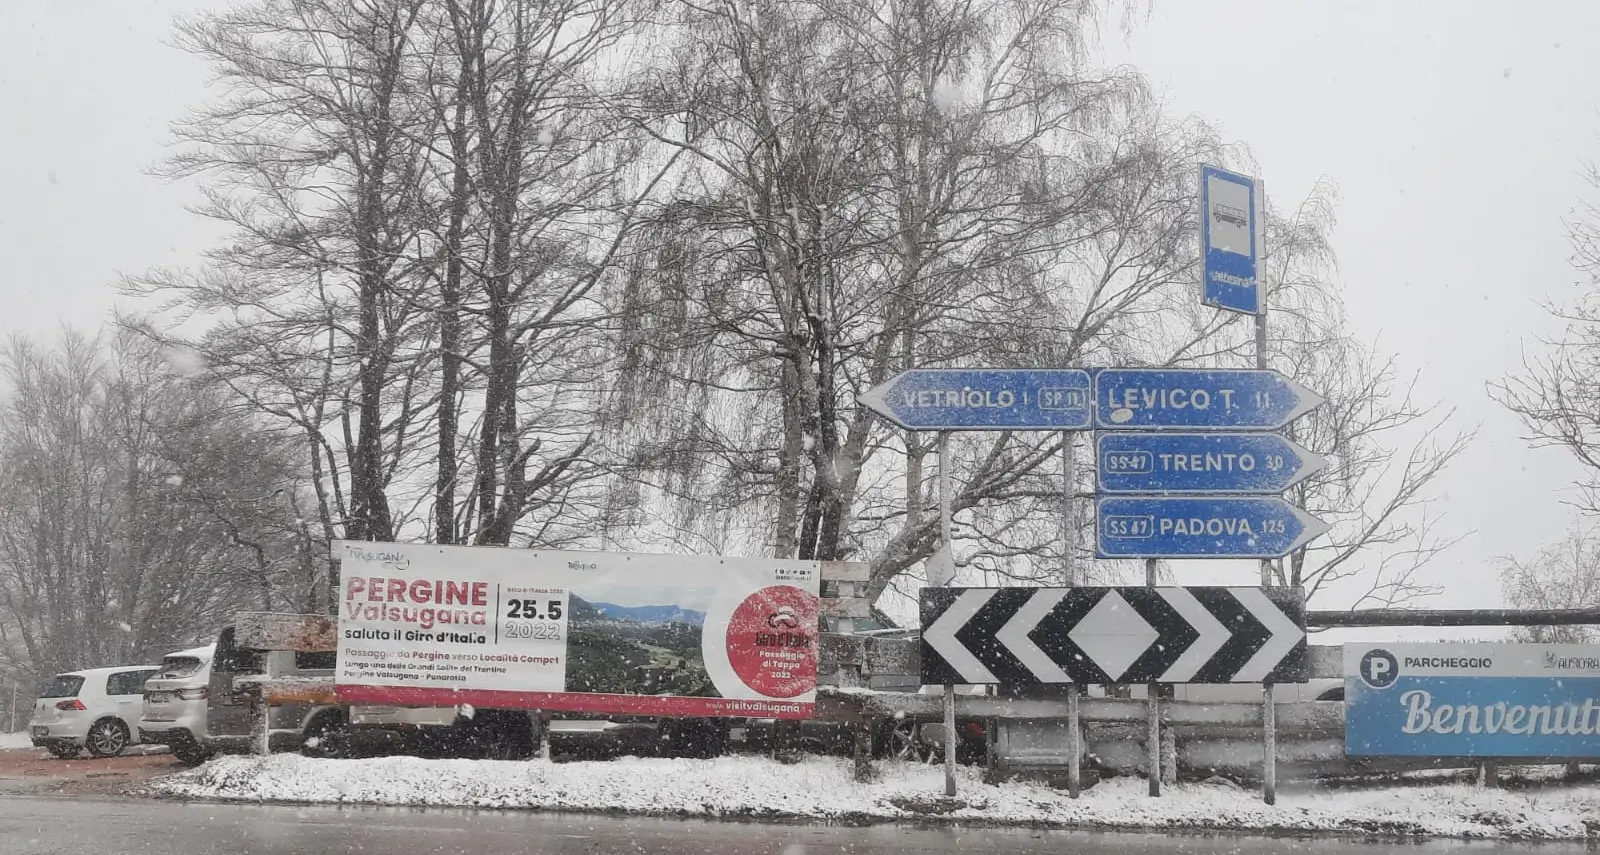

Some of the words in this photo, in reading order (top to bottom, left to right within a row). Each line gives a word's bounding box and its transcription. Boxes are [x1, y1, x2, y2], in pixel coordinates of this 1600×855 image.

[904, 390, 1014, 408] VETRIOLO
[1109, 388, 1210, 410] LEVICO
[1159, 453, 1255, 471] TRENTO
[1265, 456, 1283, 469] 30
[1110, 521, 1127, 534] SS
[1160, 518, 1251, 535] PADOVA
[1262, 520, 1285, 533] 125
[346, 576, 488, 606] PERGINE
[346, 601, 487, 629] Valsugana
[507, 598, 562, 620] 25.5
[345, 628, 390, 641] saluta
[393, 629, 401, 641] il
[405, 630, 434, 643] Giro
[504, 621, 561, 641] 2022
[345, 648, 394, 660] Passagg
[412, 651, 450, 662] Pergine
[452, 653, 478, 662] verso
[759, 650, 805, 661] Passaggio
[762, 659, 771, 668] di
[1404, 657, 1492, 669] PARCHEGGIO
[376, 671, 419, 681] Valsugana
[474, 666, 507, 674] Trentino
[771, 671, 792, 679] 2022
[1400, 689, 1600, 735] Benvenut
